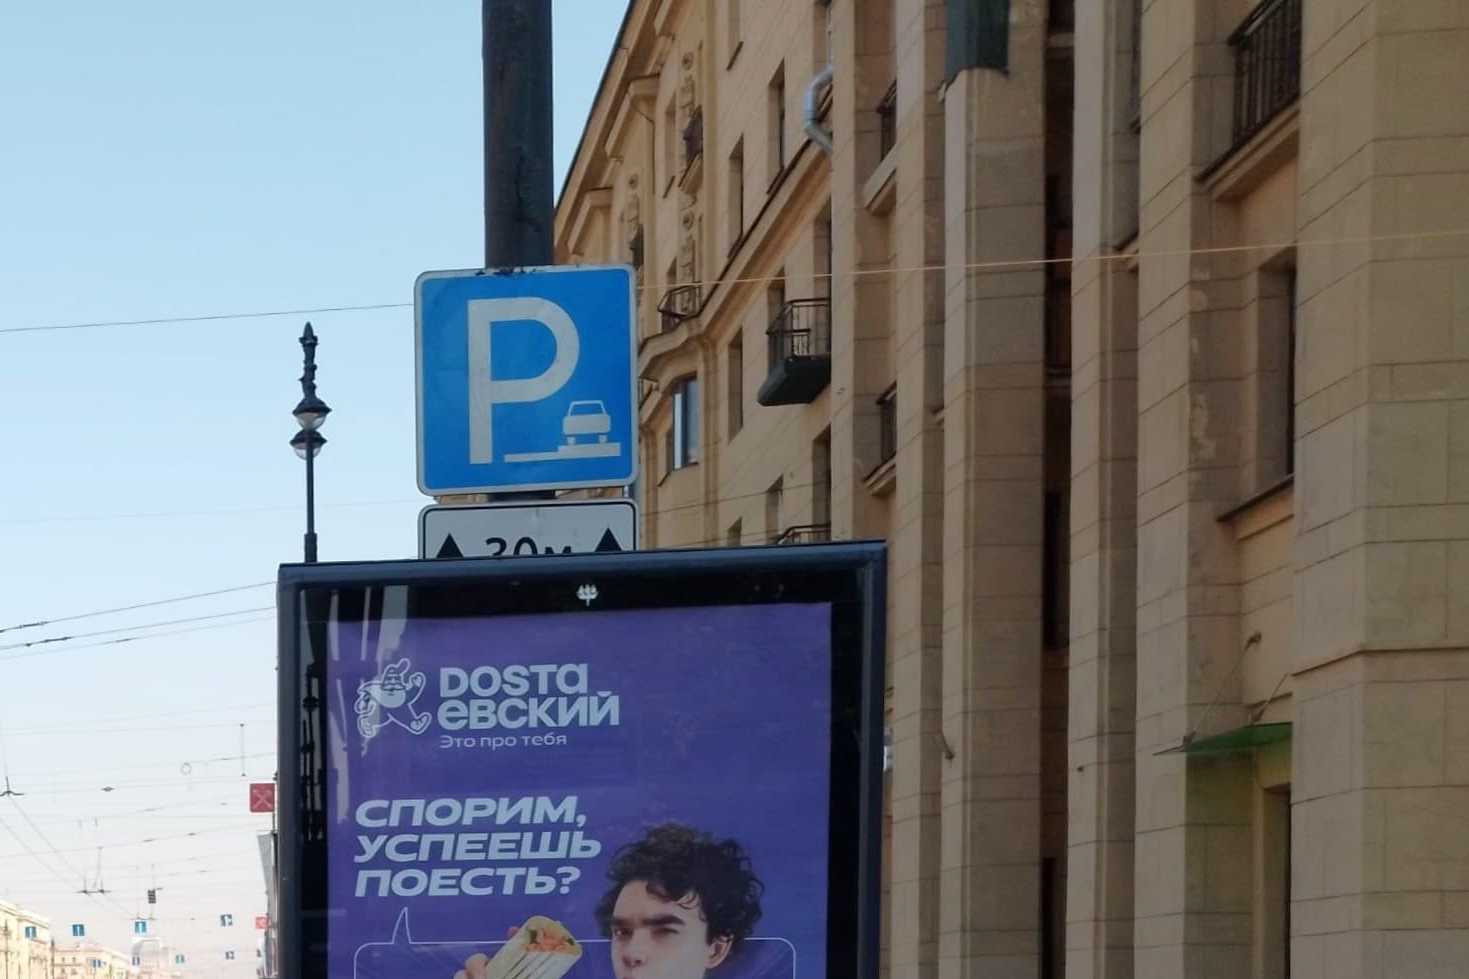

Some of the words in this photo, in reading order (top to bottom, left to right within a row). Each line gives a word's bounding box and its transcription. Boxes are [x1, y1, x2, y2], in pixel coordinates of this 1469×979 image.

[468, 297, 580, 464] P
[439, 735, 476, 749] Это
[480, 735, 517, 750] про
[520, 733, 566, 746] тебя
[355, 796, 586, 828] СПОРИМ,
[354, 831, 601, 863] УСПЕЕШЬ
[355, 865, 580, 897] ПОЕСТЬ?
